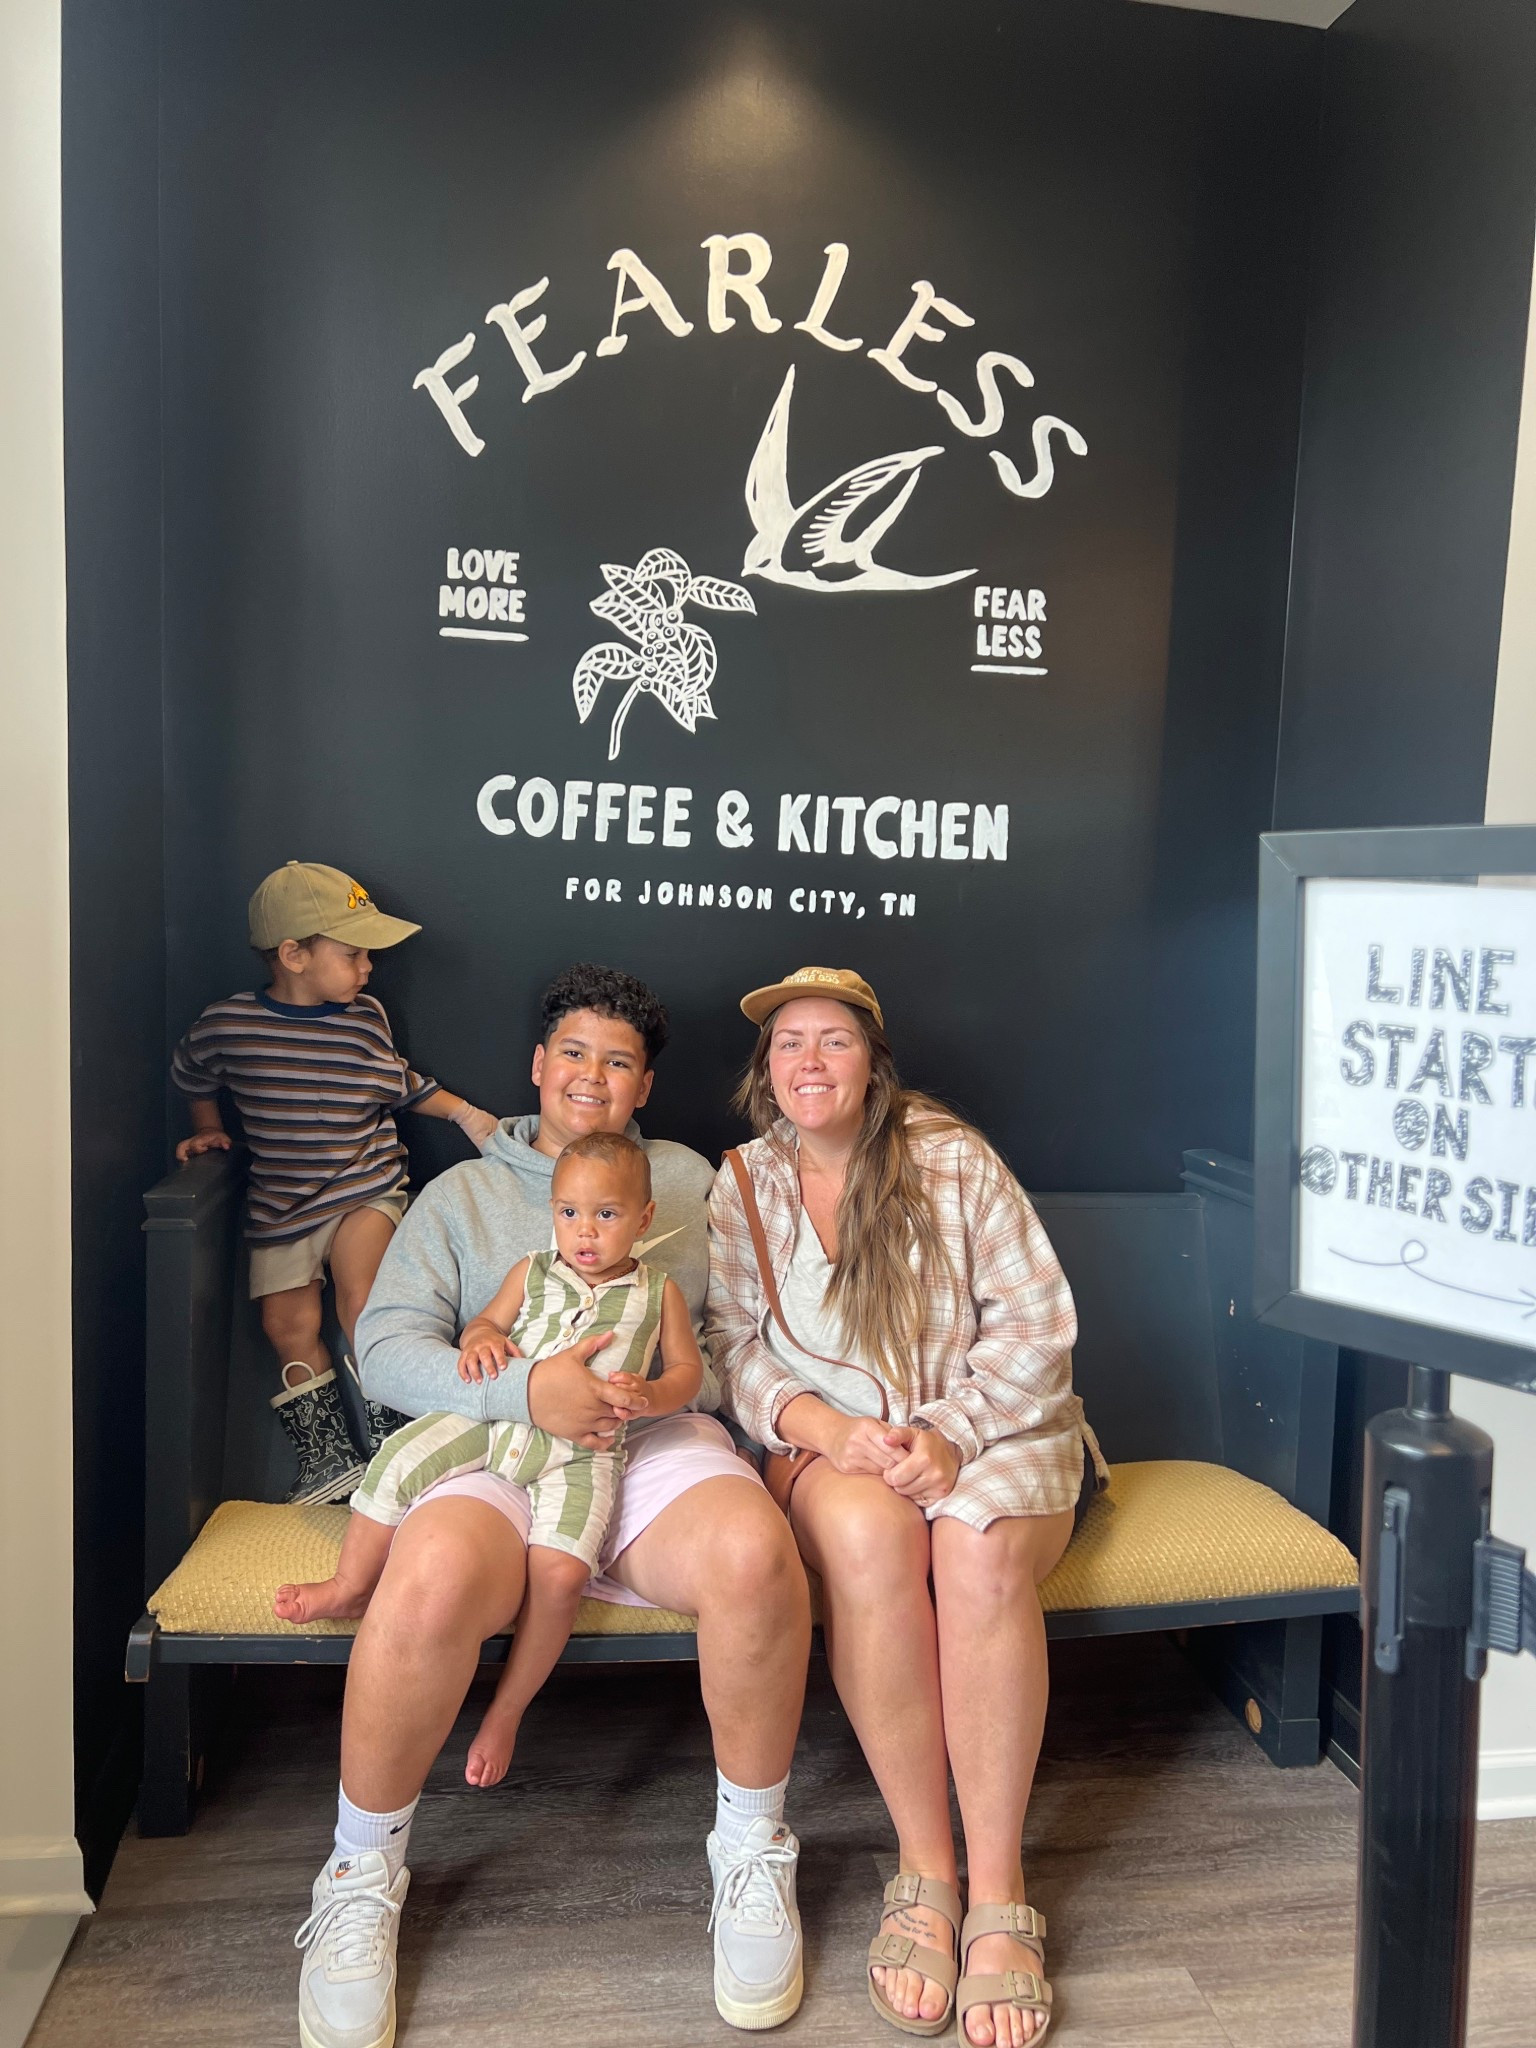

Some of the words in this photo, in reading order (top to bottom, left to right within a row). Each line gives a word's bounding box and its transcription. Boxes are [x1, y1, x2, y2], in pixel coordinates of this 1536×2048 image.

[412, 232, 1089, 499] FEARLESS
[446, 547, 521, 585] LOVE
[438, 584, 528, 623] MORE
[973, 585, 1048, 622] FEAR
[976, 623, 1043, 660] LESS
[476, 774, 693, 849] COFFEE
[715, 789, 756, 849] &
[777, 793, 1011, 863] KITCHEN
[565, 877, 623, 904] FOR
[638, 880, 774, 911] JOHNSON
[789, 887, 867, 920] CITY,
[879, 892, 917, 918] TN
[1367, 944, 1515, 1017] LINE
[1340, 1019, 1536, 1108] START
[1392, 1098, 1470, 1162] ON
[1300, 1144, 1452, 1224] OTHER
